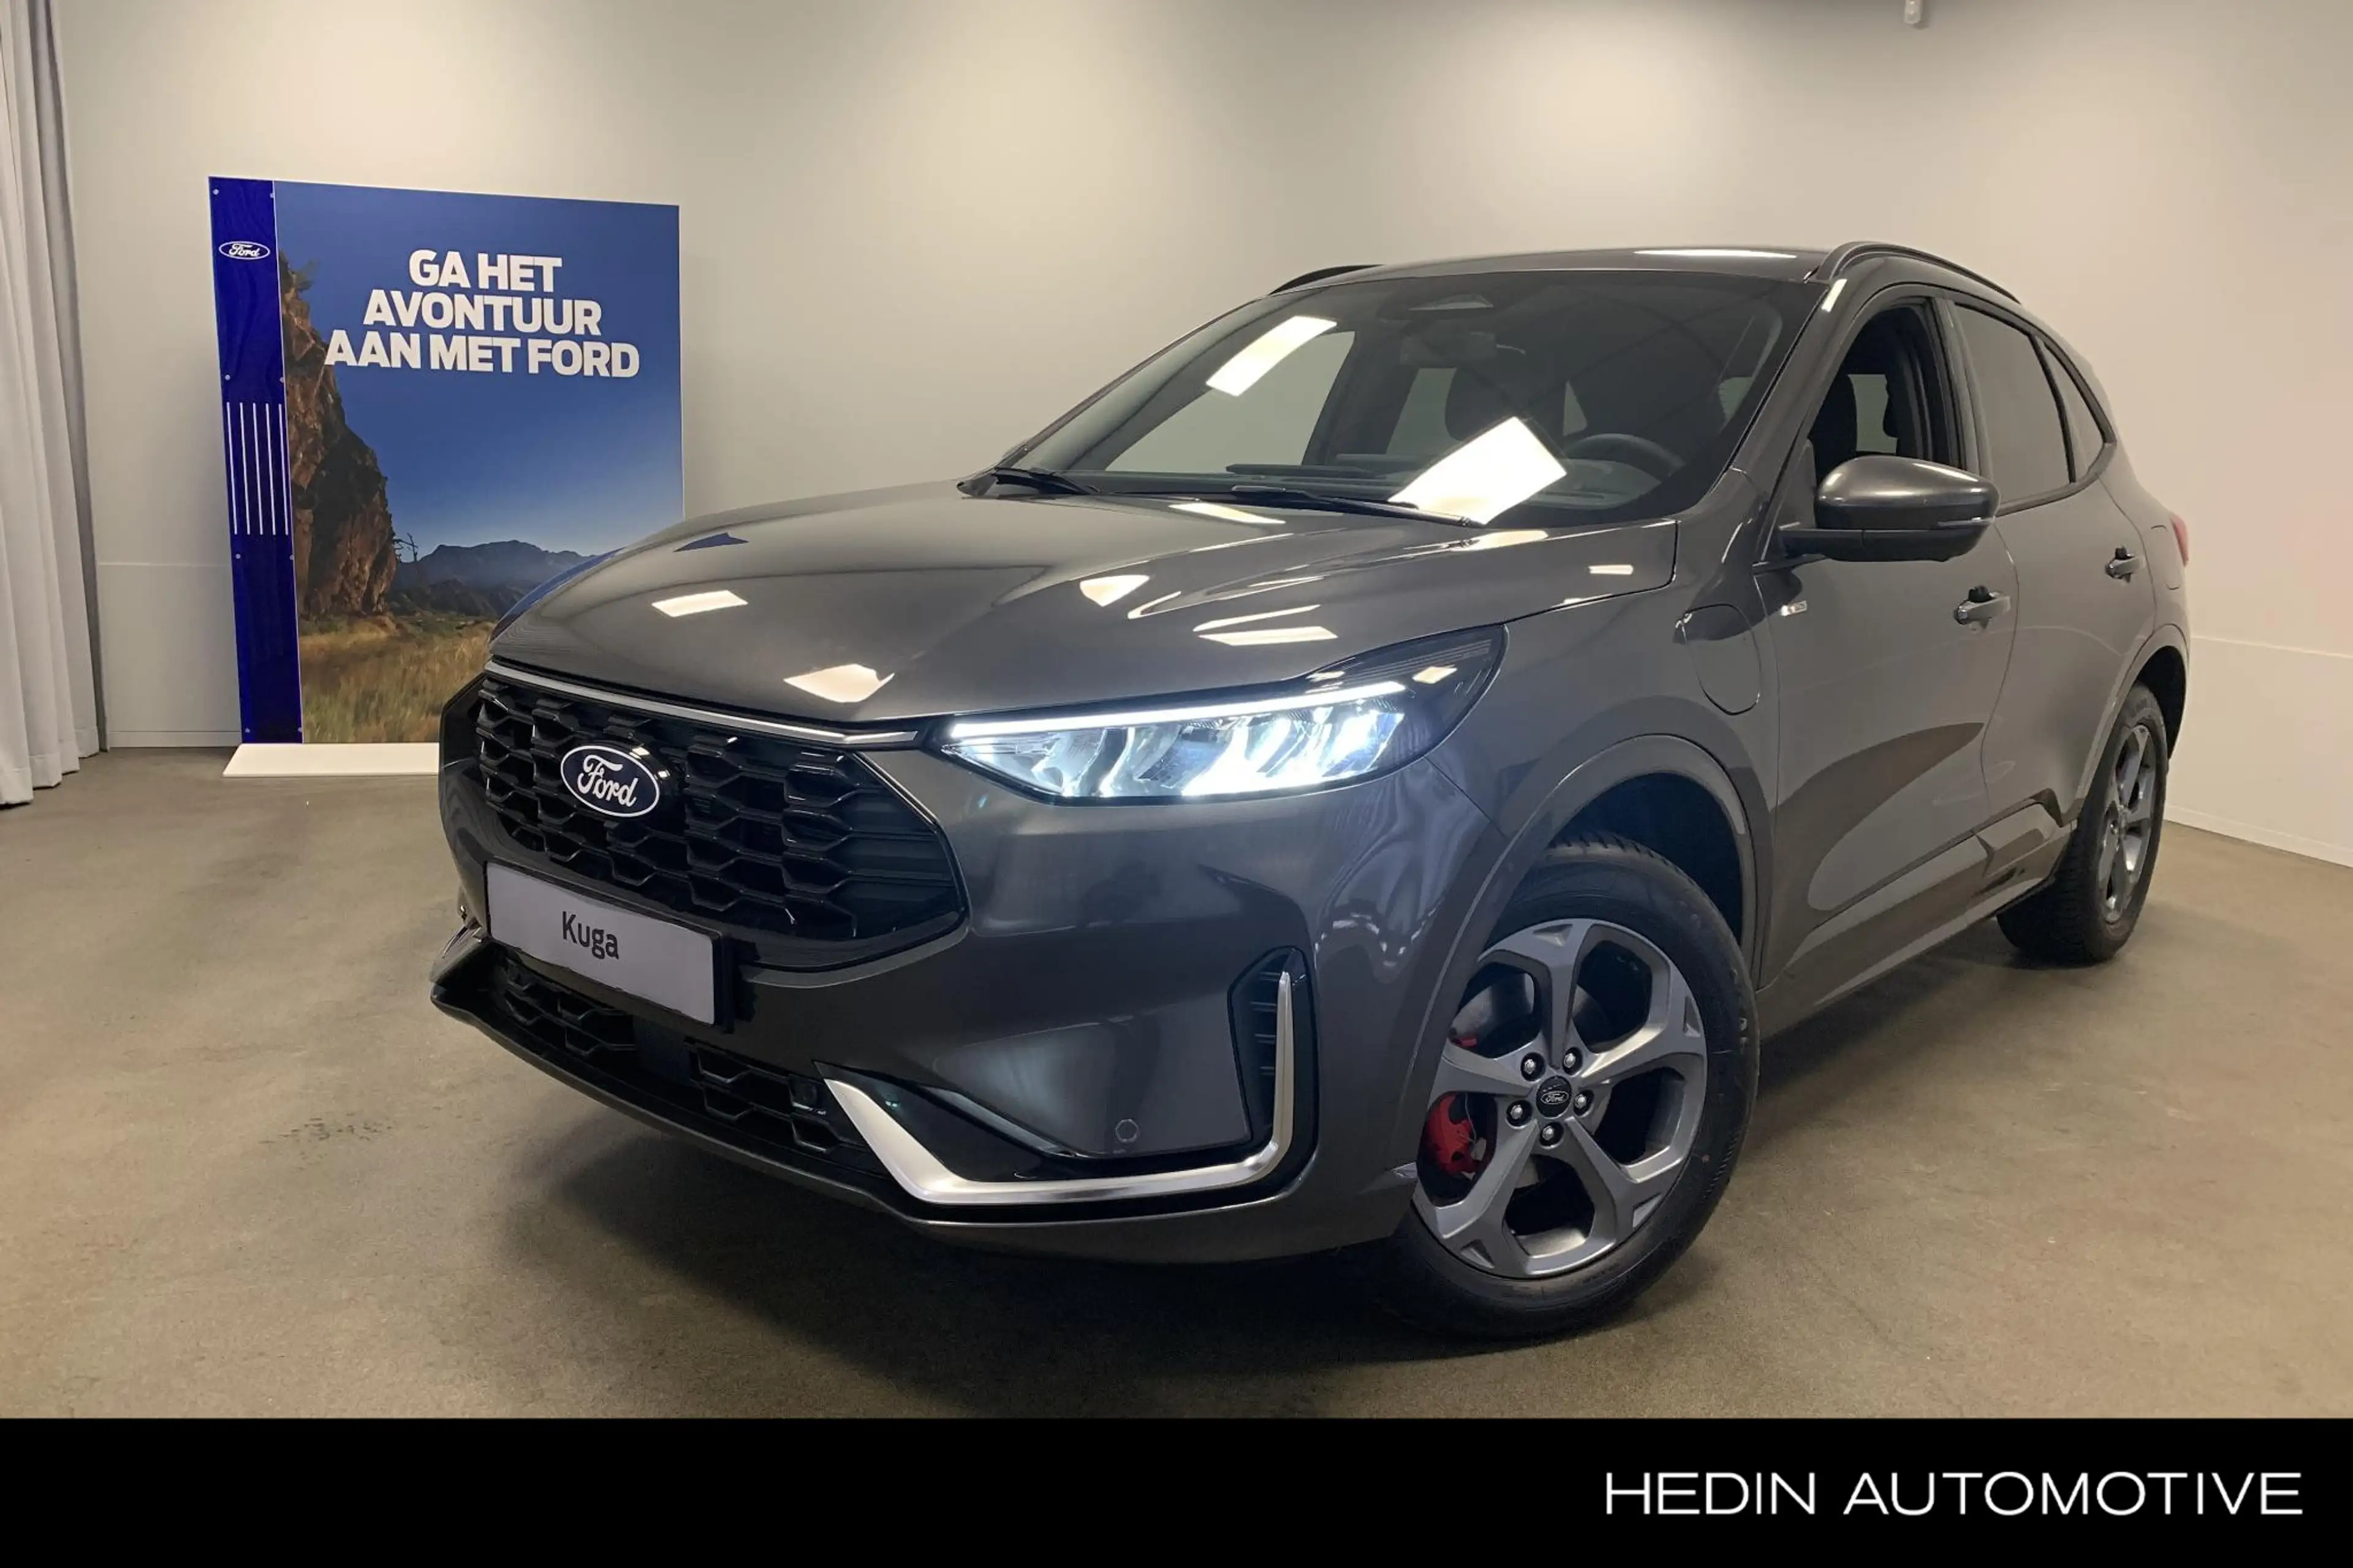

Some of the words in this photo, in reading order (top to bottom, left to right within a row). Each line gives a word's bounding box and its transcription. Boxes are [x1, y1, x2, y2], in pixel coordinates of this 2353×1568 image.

[229, 243, 260, 257] Ford
[409, 249, 471, 289] GA
[477, 253, 563, 292] HET
[363, 289, 602, 336] AVONTUUR
[324, 330, 422, 369] AAN
[429, 334, 521, 373] MET
[528, 339, 640, 377] FORD
[577, 754, 638, 807] Ford
[562, 911, 620, 960] Kuga
